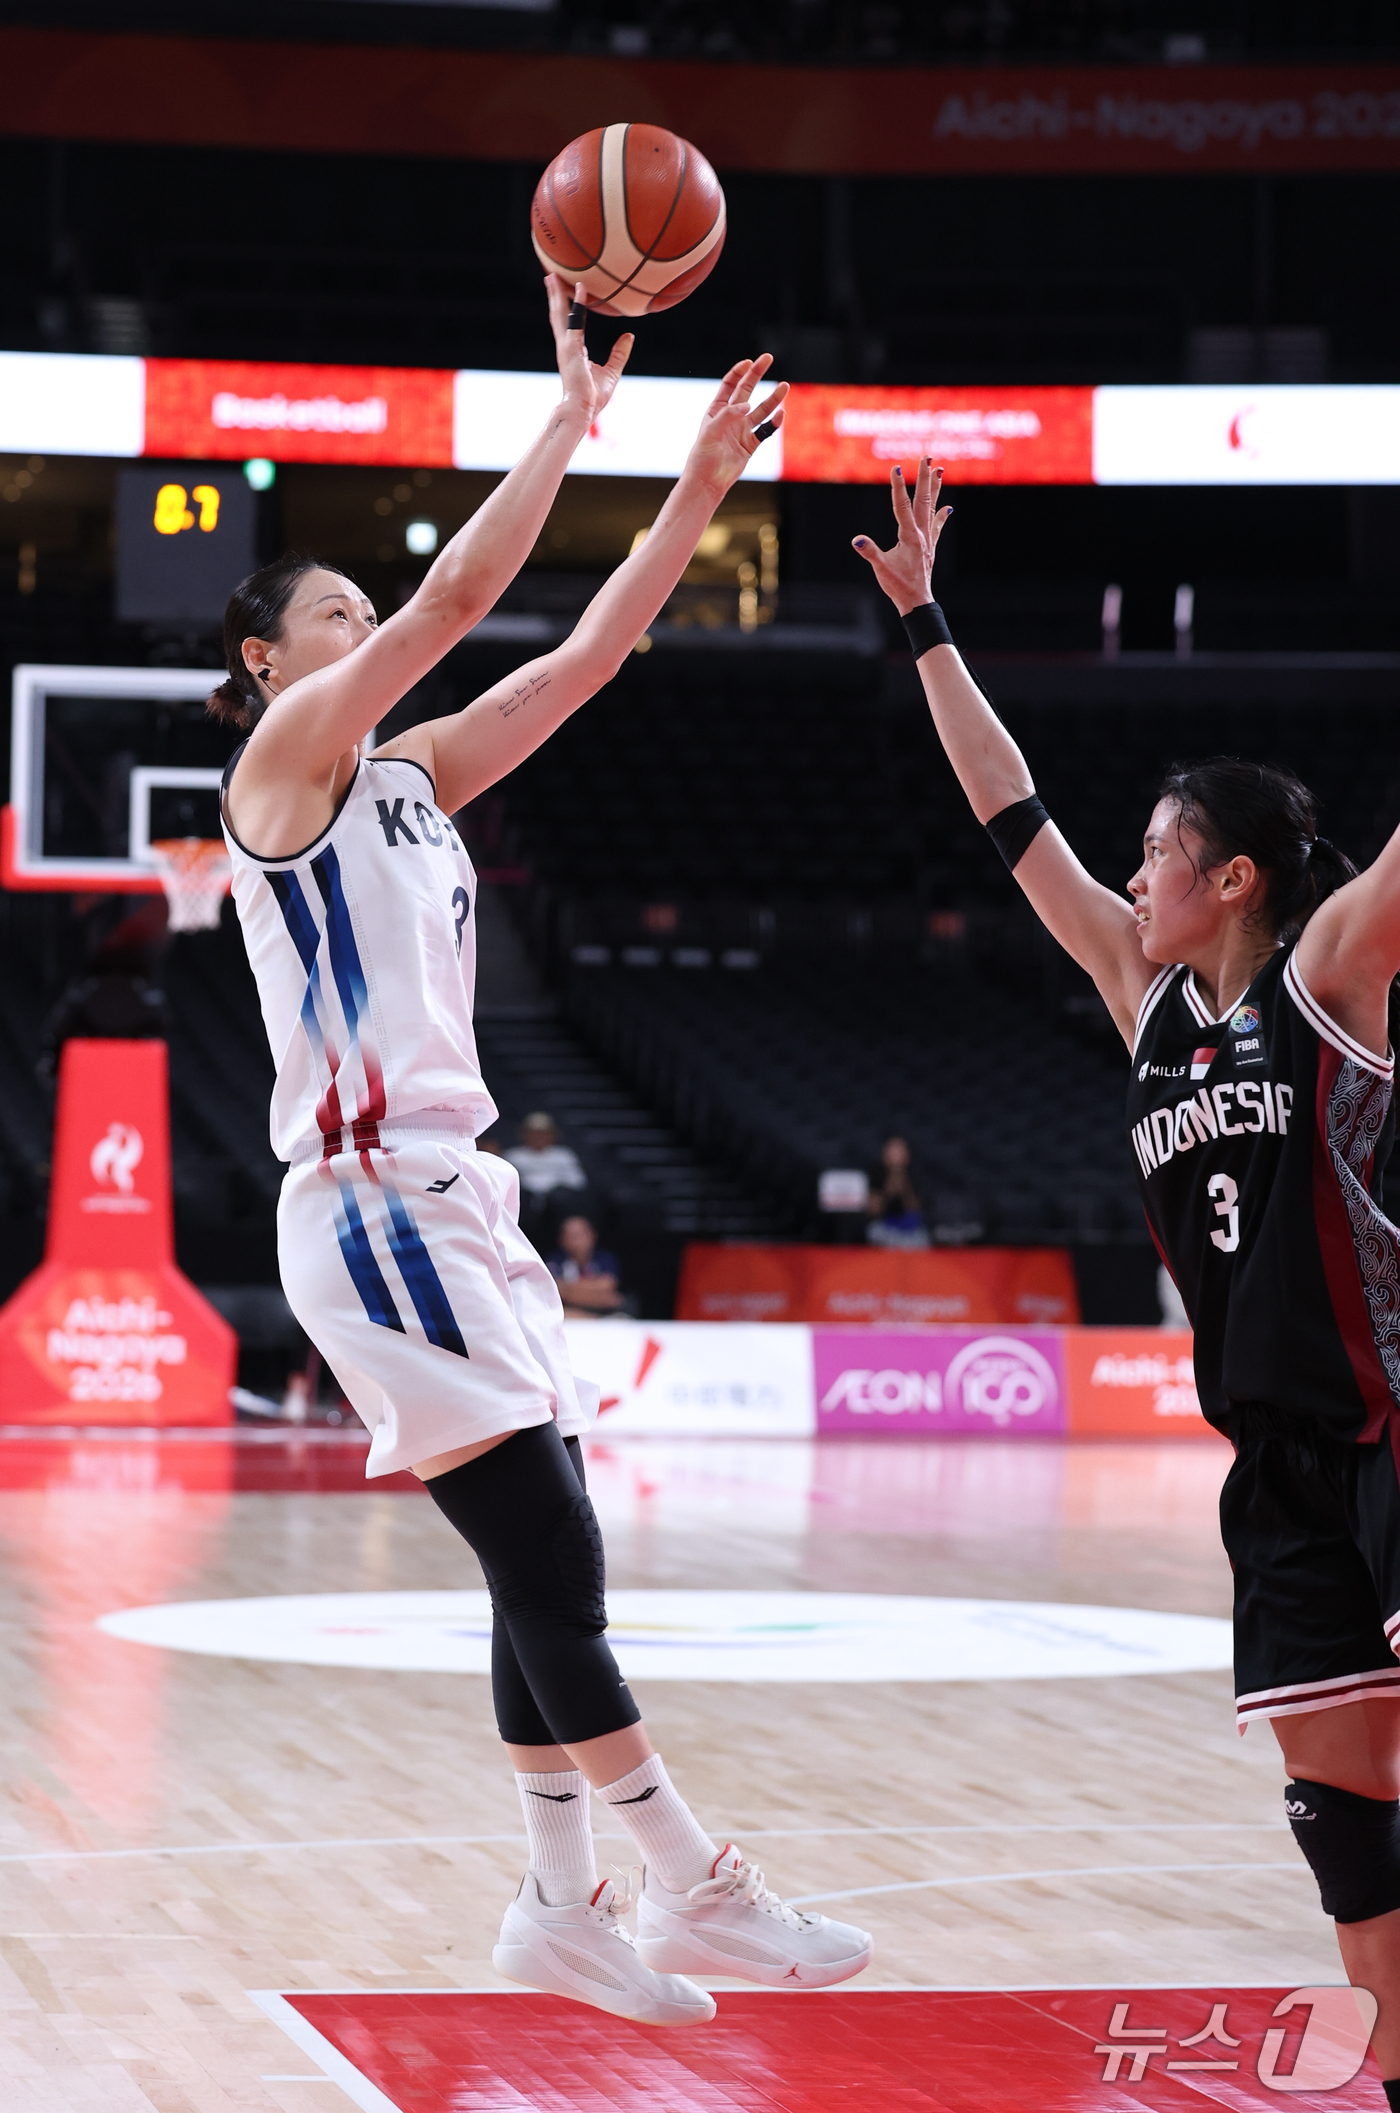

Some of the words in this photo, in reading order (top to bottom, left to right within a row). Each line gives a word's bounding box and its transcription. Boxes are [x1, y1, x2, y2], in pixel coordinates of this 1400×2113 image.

[1235, 1038, 1260, 1053] FIBA
[1150, 1065, 1186, 1078] MILLS
[1207, 1172, 1240, 1253] 3
